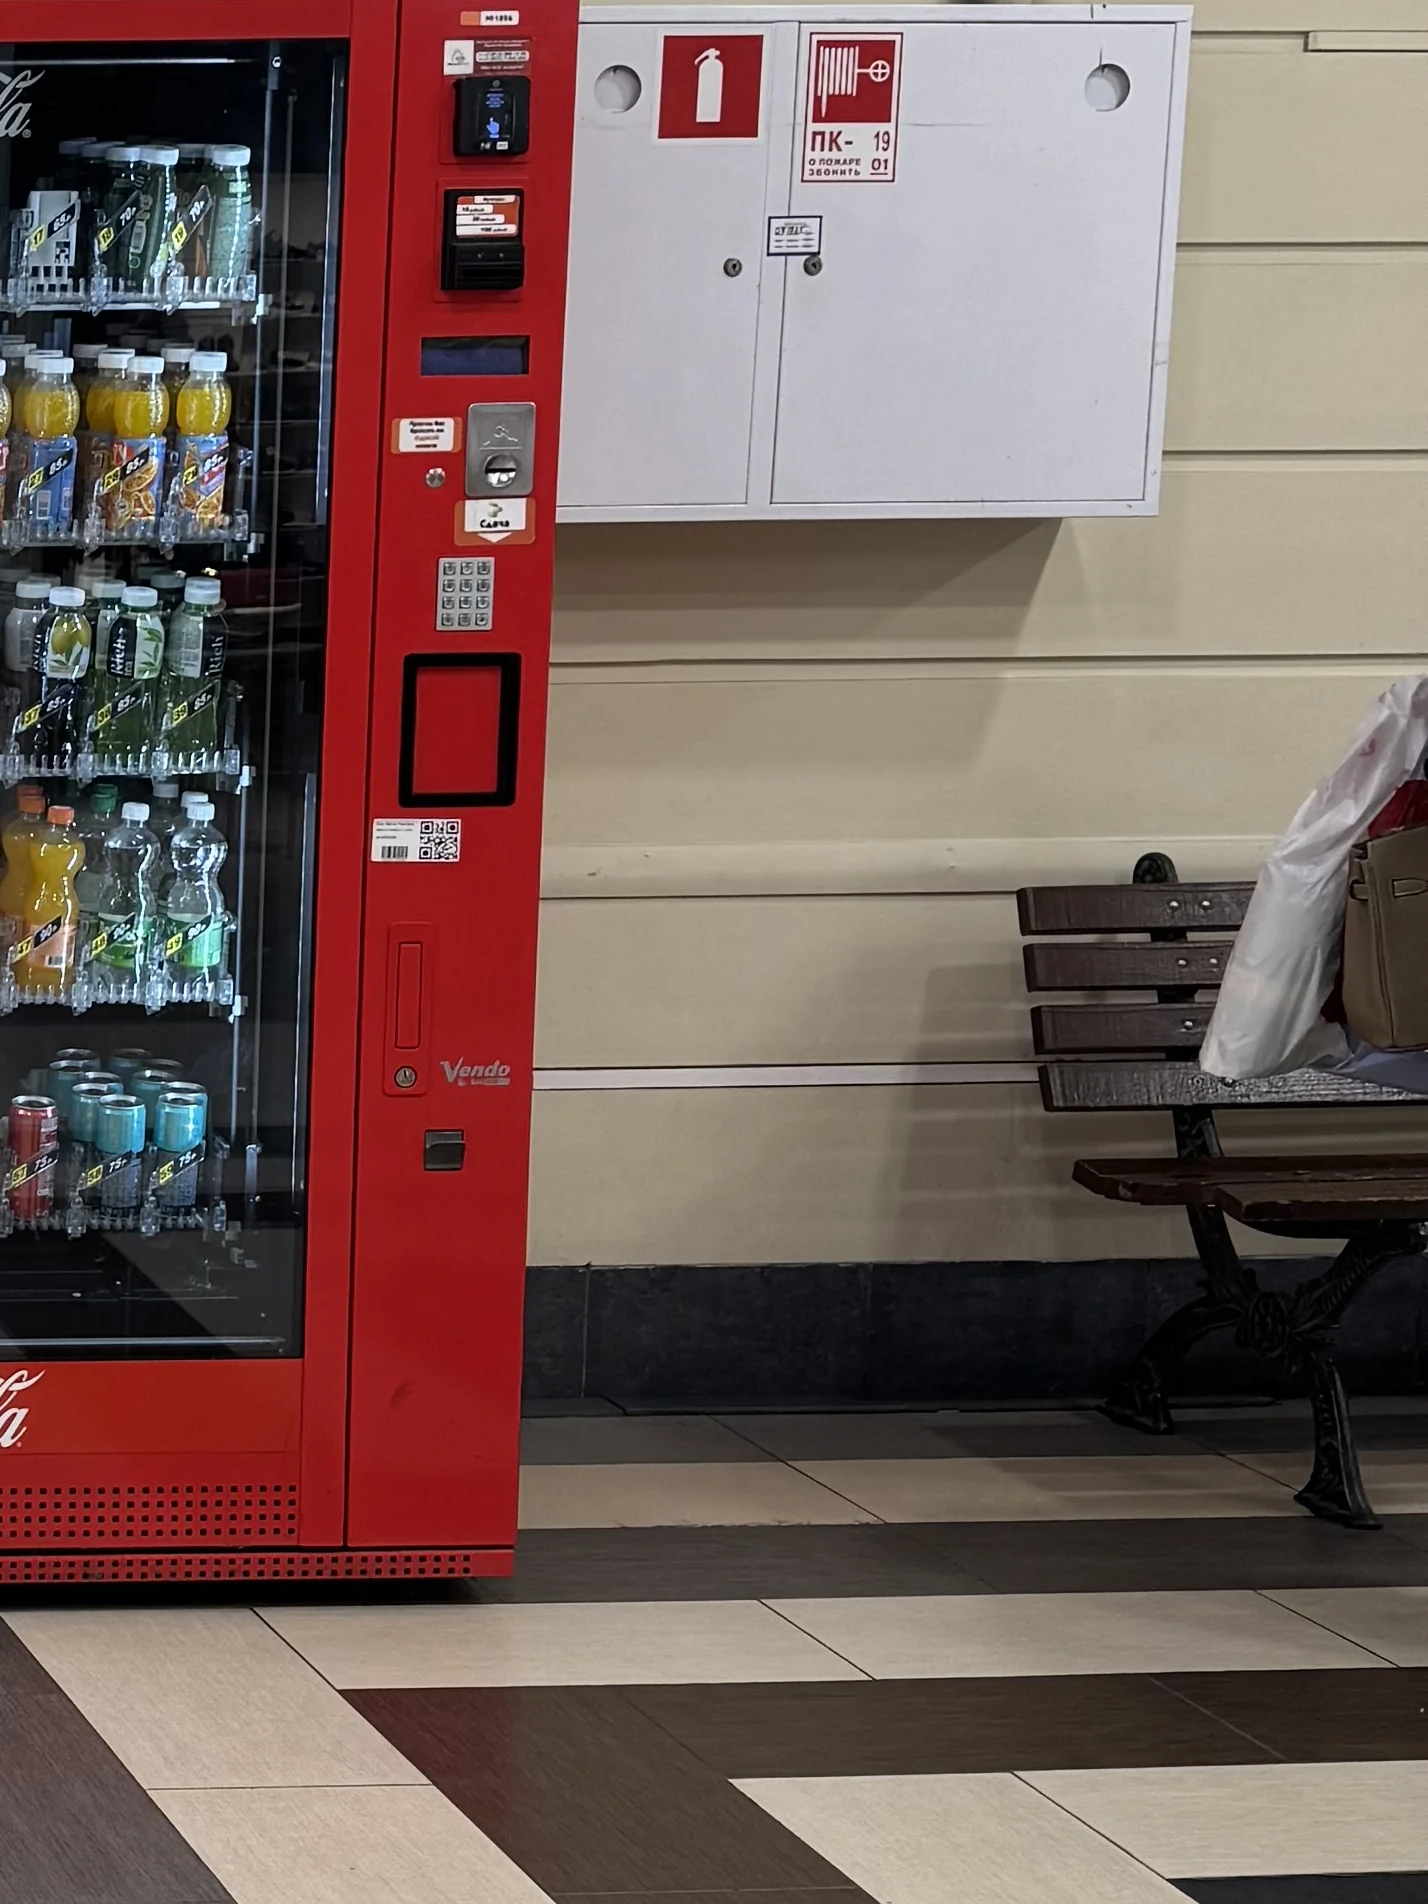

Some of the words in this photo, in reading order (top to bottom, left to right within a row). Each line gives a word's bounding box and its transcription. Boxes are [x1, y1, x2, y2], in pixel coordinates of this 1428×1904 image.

[873, 130, 891, 152] 19
[819, 158, 861, 166] ПОЖАРЕ
[870, 158, 889, 171] 01
[808, 168, 861, 176] ЗВОНИТЬ
[440, 1056, 511, 1083] Vendo
